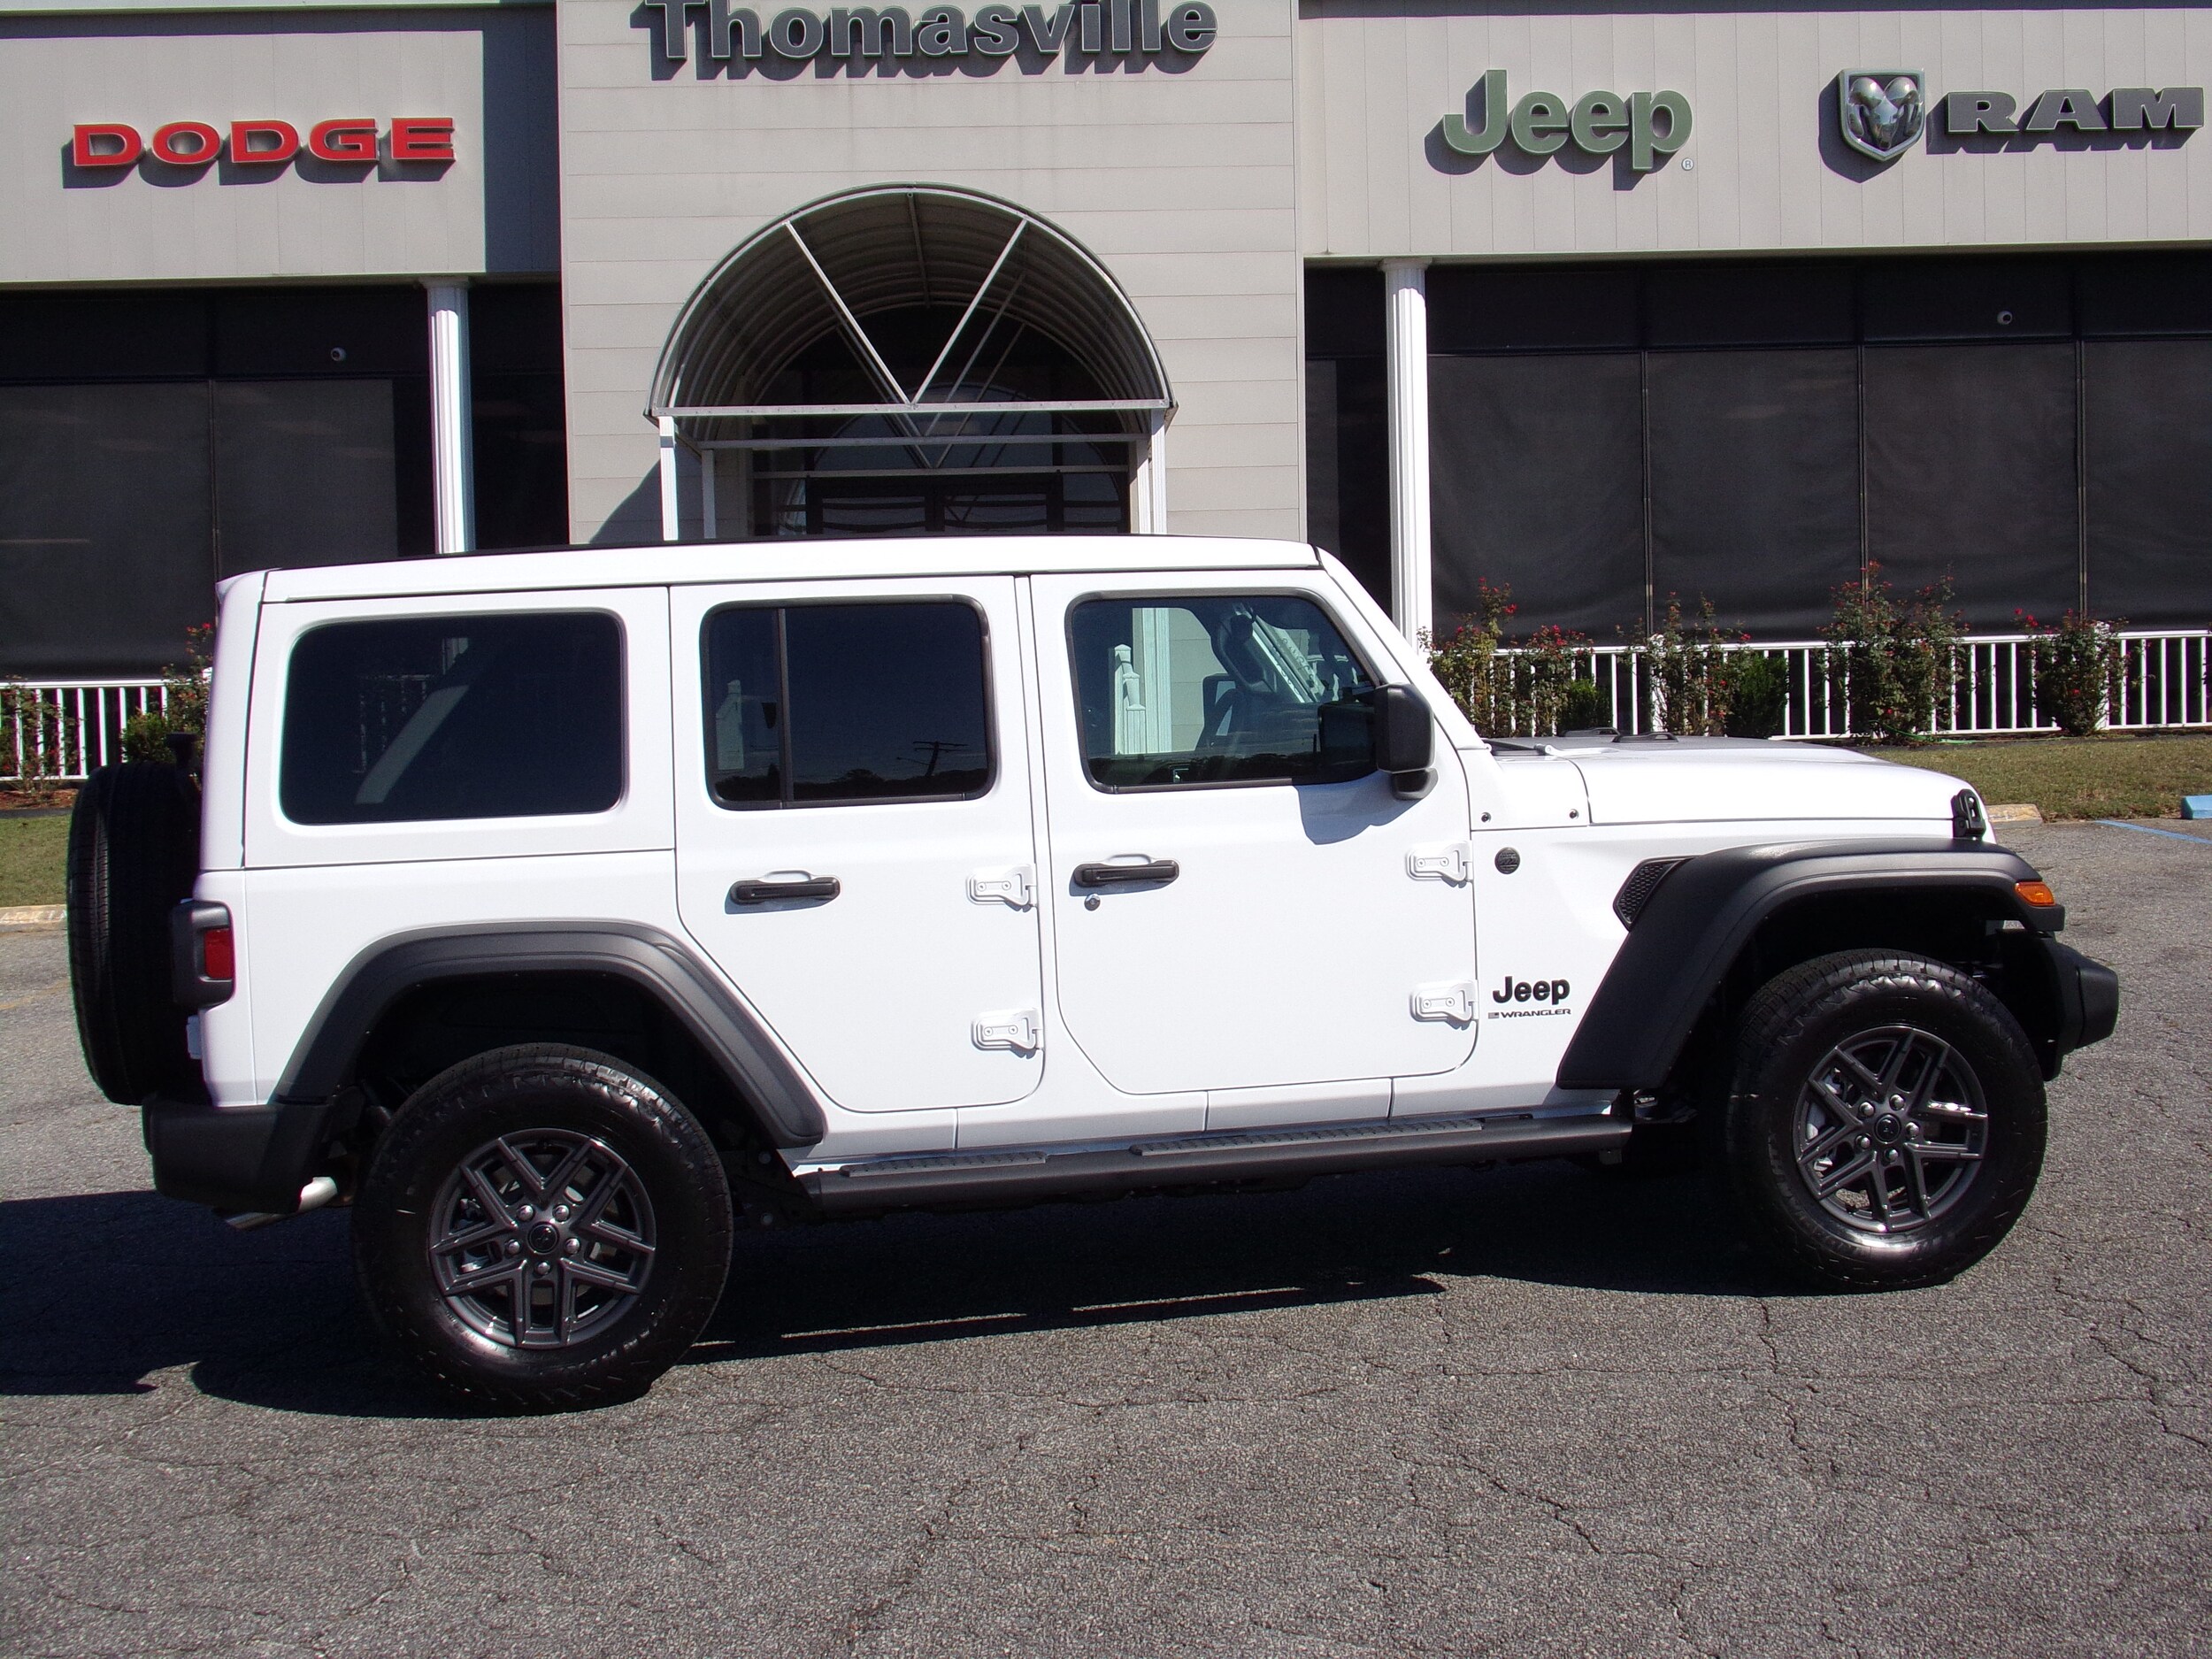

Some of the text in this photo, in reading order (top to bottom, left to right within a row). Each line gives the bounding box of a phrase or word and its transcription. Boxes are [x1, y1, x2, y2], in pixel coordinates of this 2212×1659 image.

[645, 0, 1218, 59] Thomasville
[1443, 69, 1693, 170] Jeep
[1947, 87, 2204, 133] RAM
[73, 117, 456, 167] DODGE
[1492, 976, 1571, 1005] Jeep
[1501, 1009, 1571, 1018] WRANGLER
